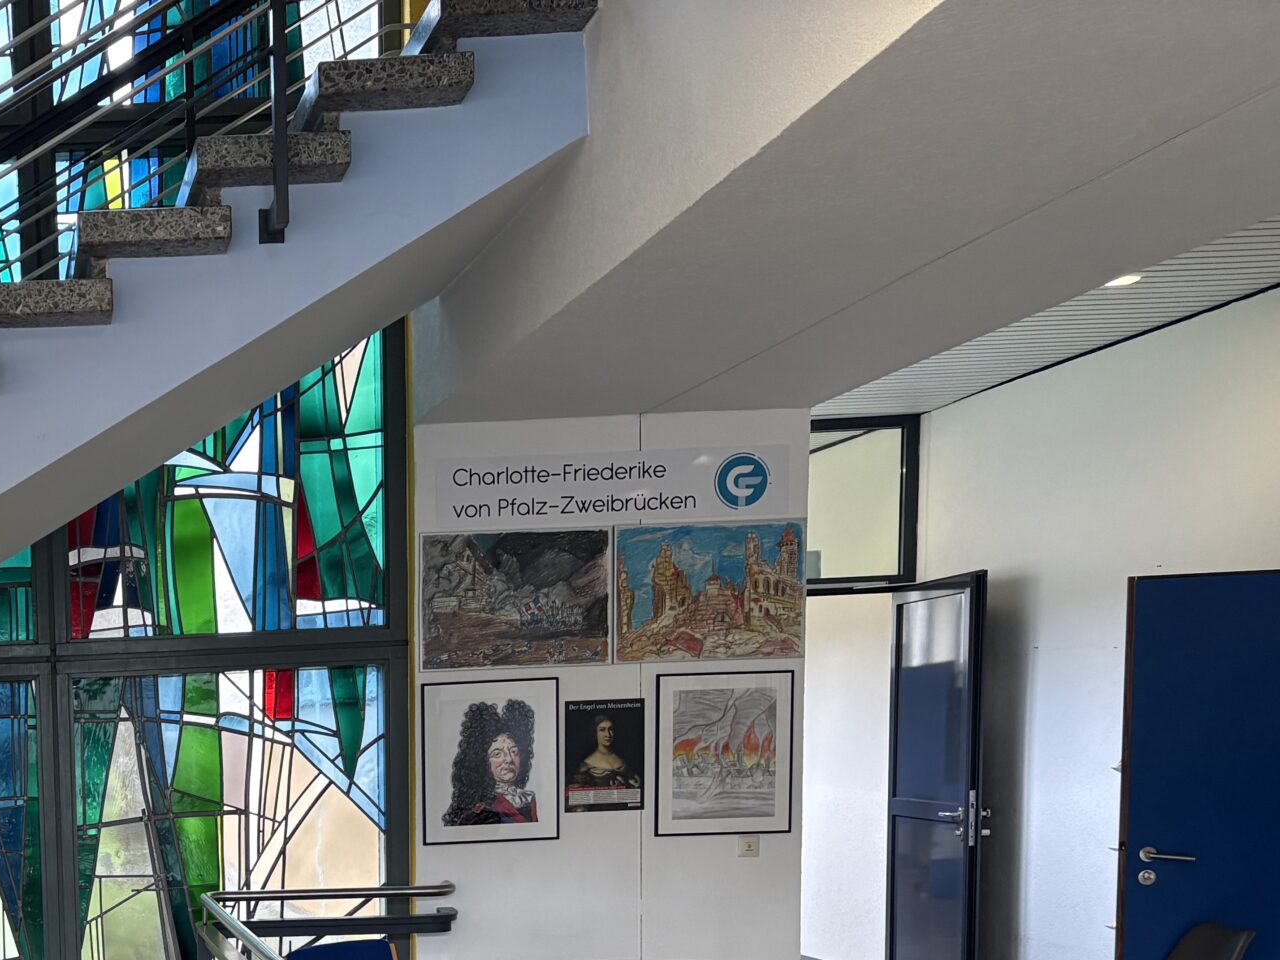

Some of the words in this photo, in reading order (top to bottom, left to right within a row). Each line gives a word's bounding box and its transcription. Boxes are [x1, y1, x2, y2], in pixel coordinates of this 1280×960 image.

[452, 461, 667, 487] Charlotte-Friederike
[452, 502, 491, 518] von
[498, 491, 697, 517] Pfalz-Zweibrücken
[580, 703, 595, 711] Engel
